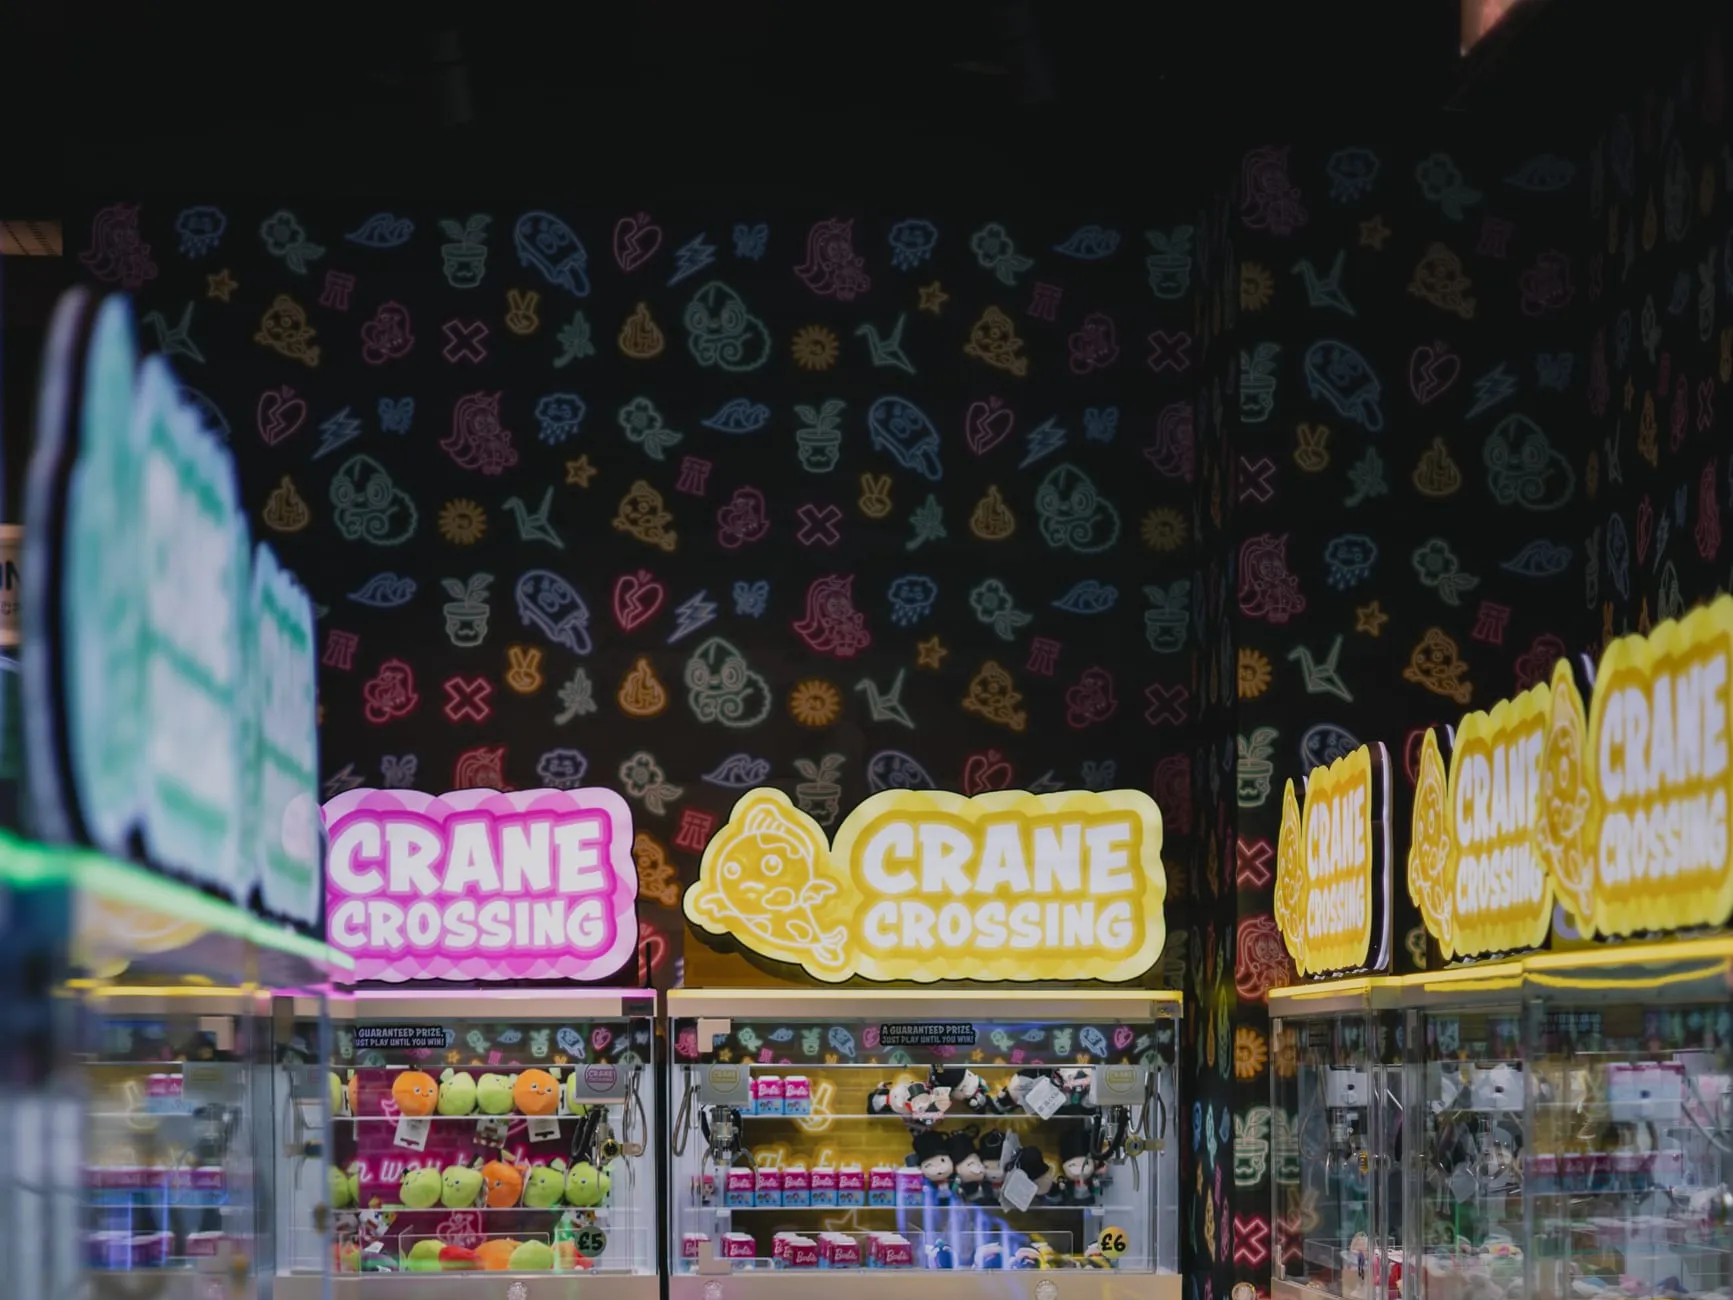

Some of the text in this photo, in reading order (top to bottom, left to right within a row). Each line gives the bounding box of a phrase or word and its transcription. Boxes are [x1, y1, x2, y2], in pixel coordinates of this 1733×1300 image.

[1601, 653, 1728, 802] CRANE
[1456, 729, 1542, 847] CRANE
[328, 818, 603, 896] CRANE
[1307, 784, 1365, 880] CRANE
[1600, 788, 1728, 887] CROSSING
[862, 820, 1135, 897] CRANE
[1456, 843, 1544, 916] CROSSING
[329, 899, 604, 948] CROSSING
[862, 900, 1135, 949] CROSSING
[1306, 886, 1365, 940] CROSSING
[355, 1038, 369, 1047] UST
[371, 1038, 389, 1047] PLAY
[390, 1038, 411, 1047] UNTIL
[412, 1038, 426, 1047] YOU
[359, 1028, 414, 1037] GUARANTEED
[882, 1025, 888, 1034] A
[890, 1025, 944, 1034] GUARANTEED
[882, 1035, 899, 1043] JUST
[901, 1035, 919, 1043] PLAY
[920, 1035, 940, 1043] UNTIL
[942, 1035, 956, 1043] YOU
[577, 1234, 604, 1250] £5
[1101, 1233, 1127, 1252] £6
